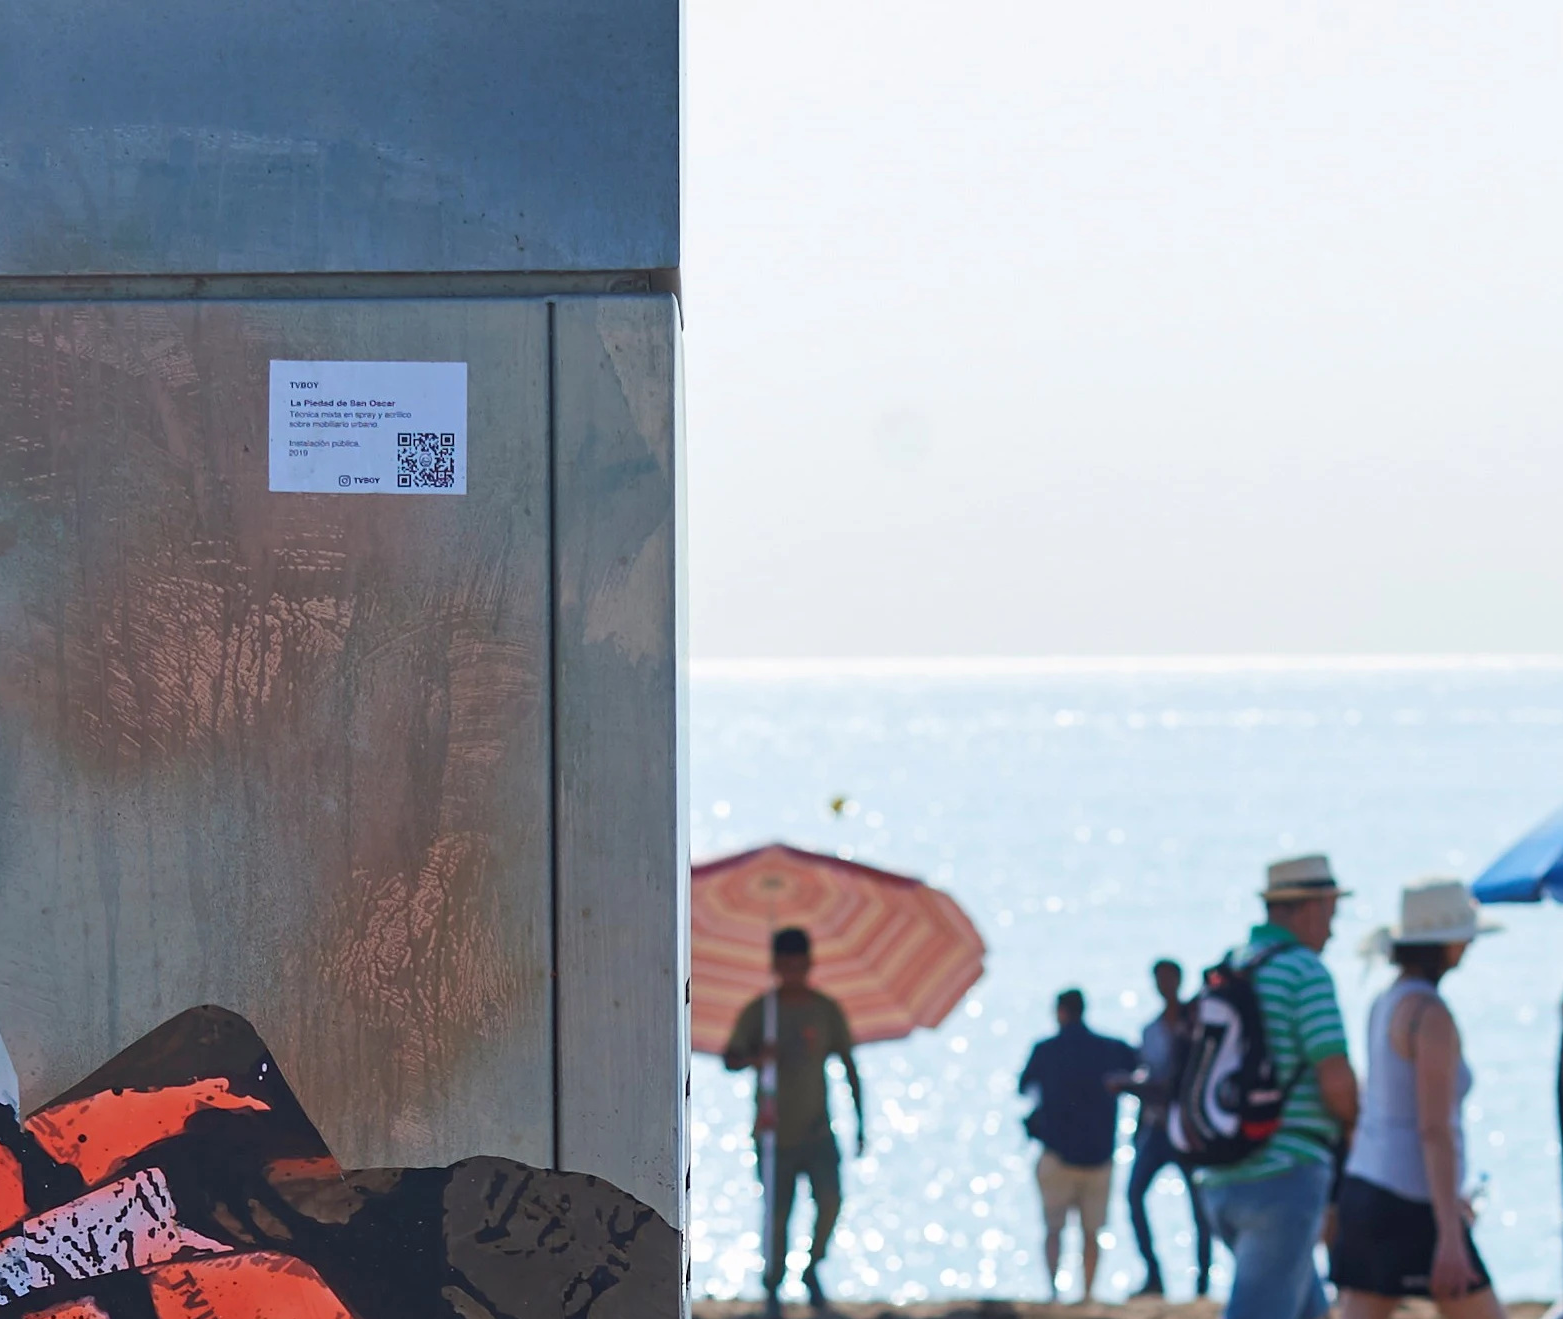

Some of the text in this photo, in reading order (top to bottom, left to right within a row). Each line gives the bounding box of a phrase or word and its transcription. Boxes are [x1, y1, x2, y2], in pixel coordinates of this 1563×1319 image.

[290, 381, 319, 389] TVBOY
[290, 399, 396, 407] La Piedad de San Oscar
[355, 412, 376, 420] spray
[377, 412, 383, 420] y
[289, 449, 308, 457] 2019
